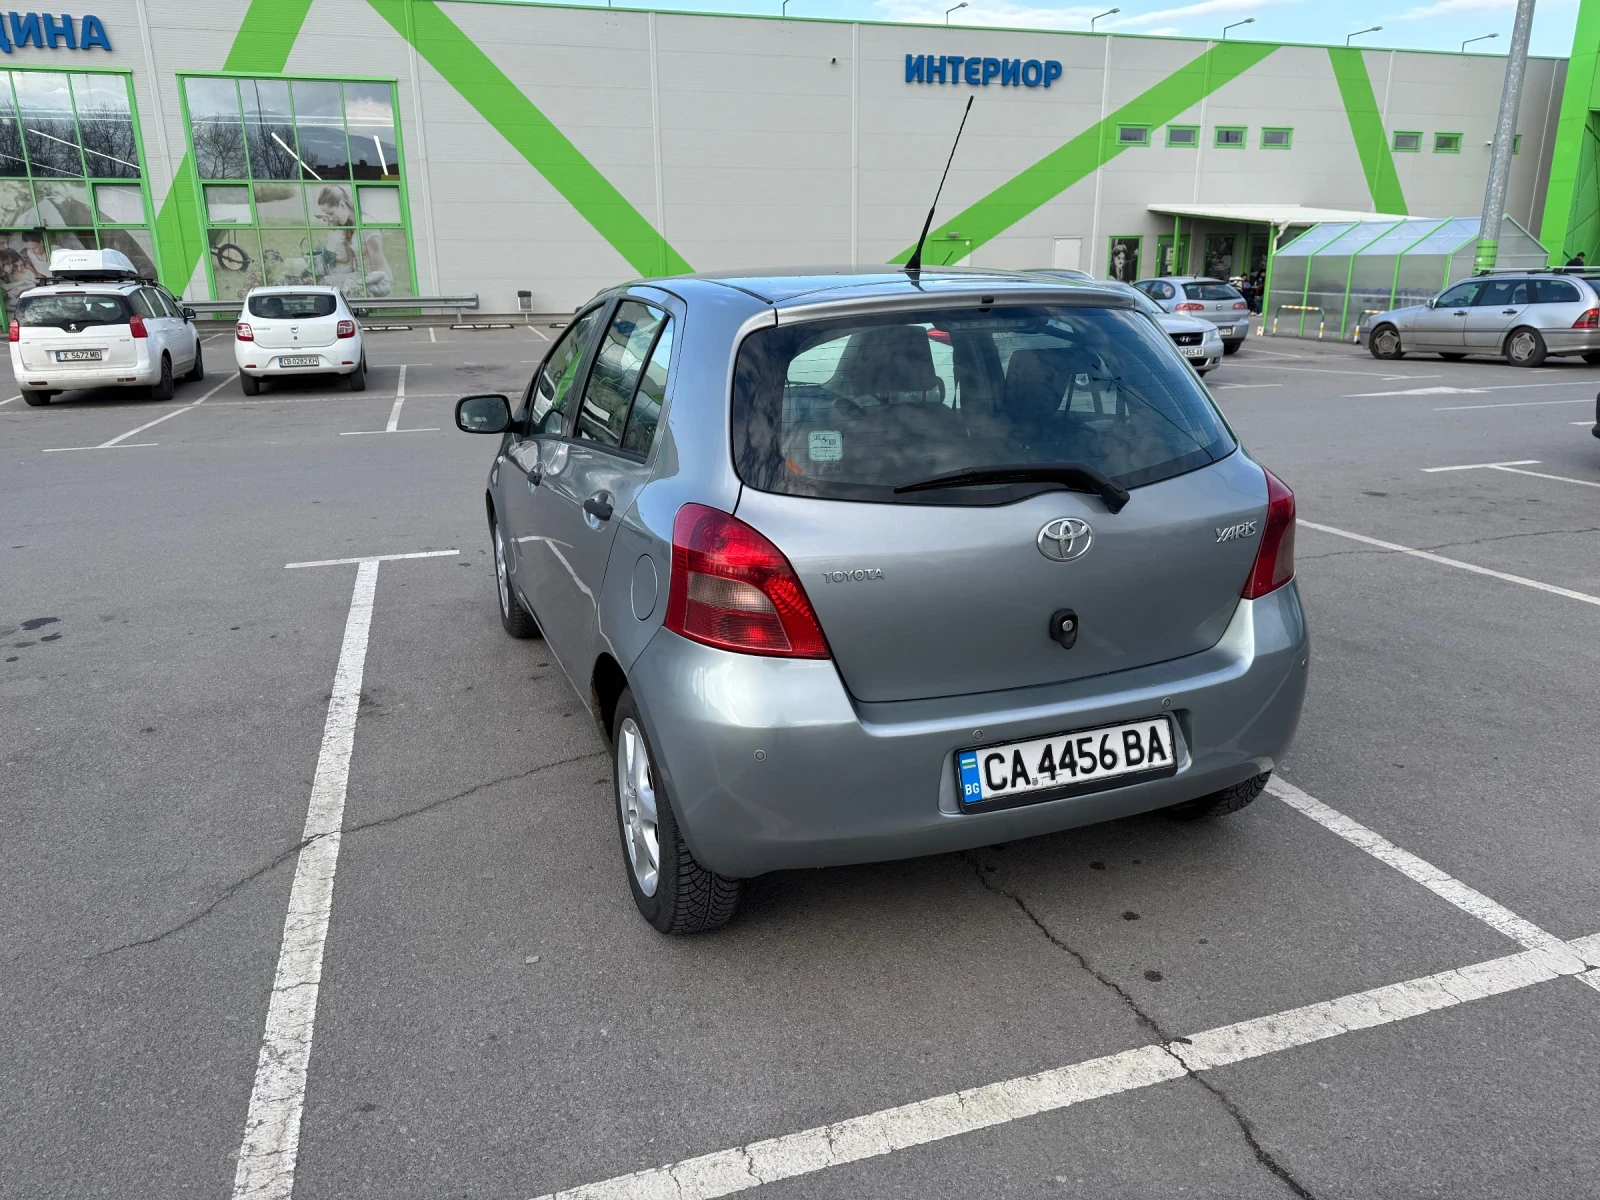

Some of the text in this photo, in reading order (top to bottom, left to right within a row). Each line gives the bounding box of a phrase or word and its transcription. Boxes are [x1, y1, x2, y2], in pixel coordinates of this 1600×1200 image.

[905, 54, 1063, 87] ИНТЕРИОР
[71, 351, 90, 359] 5672
[822, 567, 885, 584] TOYOTA
[984, 725, 1168, 791] CA 4456 BA
[965, 782, 980, 796] BG
